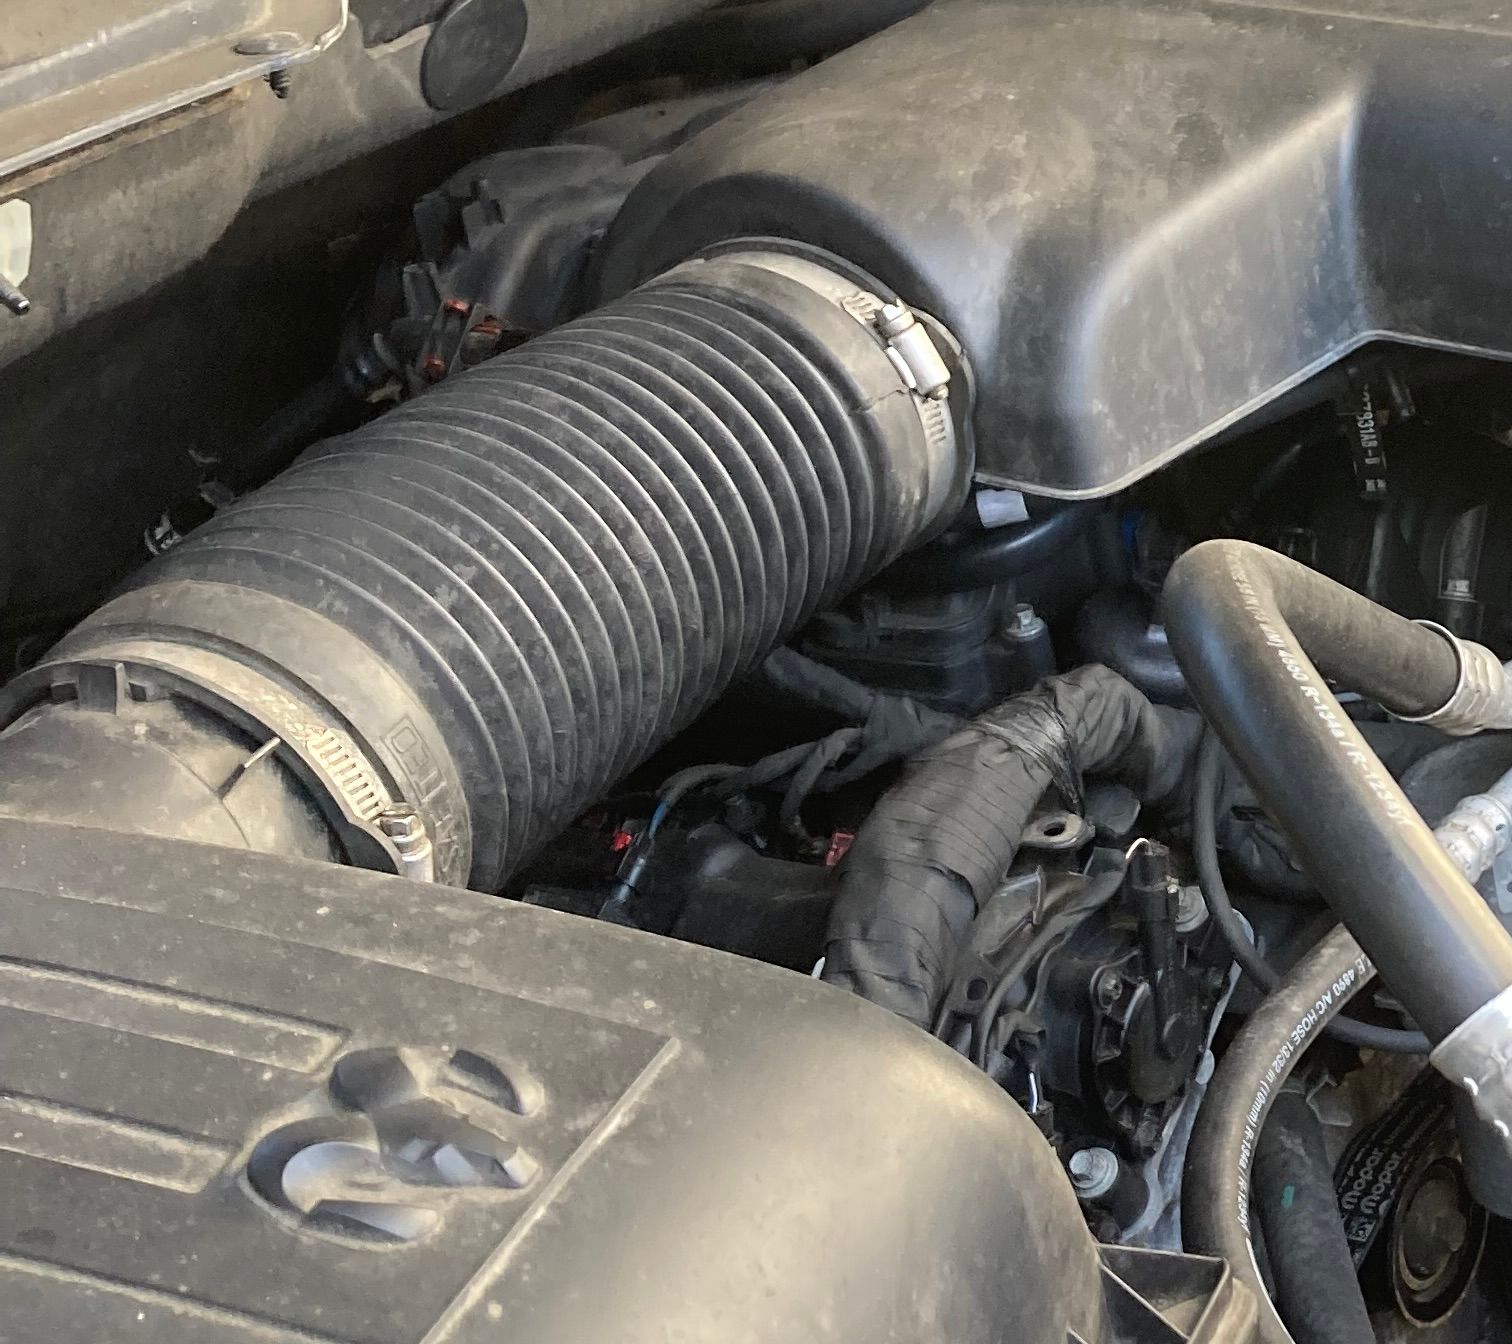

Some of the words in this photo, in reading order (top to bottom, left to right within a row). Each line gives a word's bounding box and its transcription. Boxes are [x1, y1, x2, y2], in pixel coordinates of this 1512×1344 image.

[1300, 684, 1346, 739] R-134a
[1313, 988, 1334, 1017] A/C
[1333, 970, 1357, 998] 4890
[1292, 1009, 1320, 1049] HOSE
[1265, 1069, 1277, 1084] in
[1274, 1039, 1297, 1076] 13/32
[1247, 1080, 1271, 1129] (10mm)
[1236, 1125, 1257, 1168] R-134a
